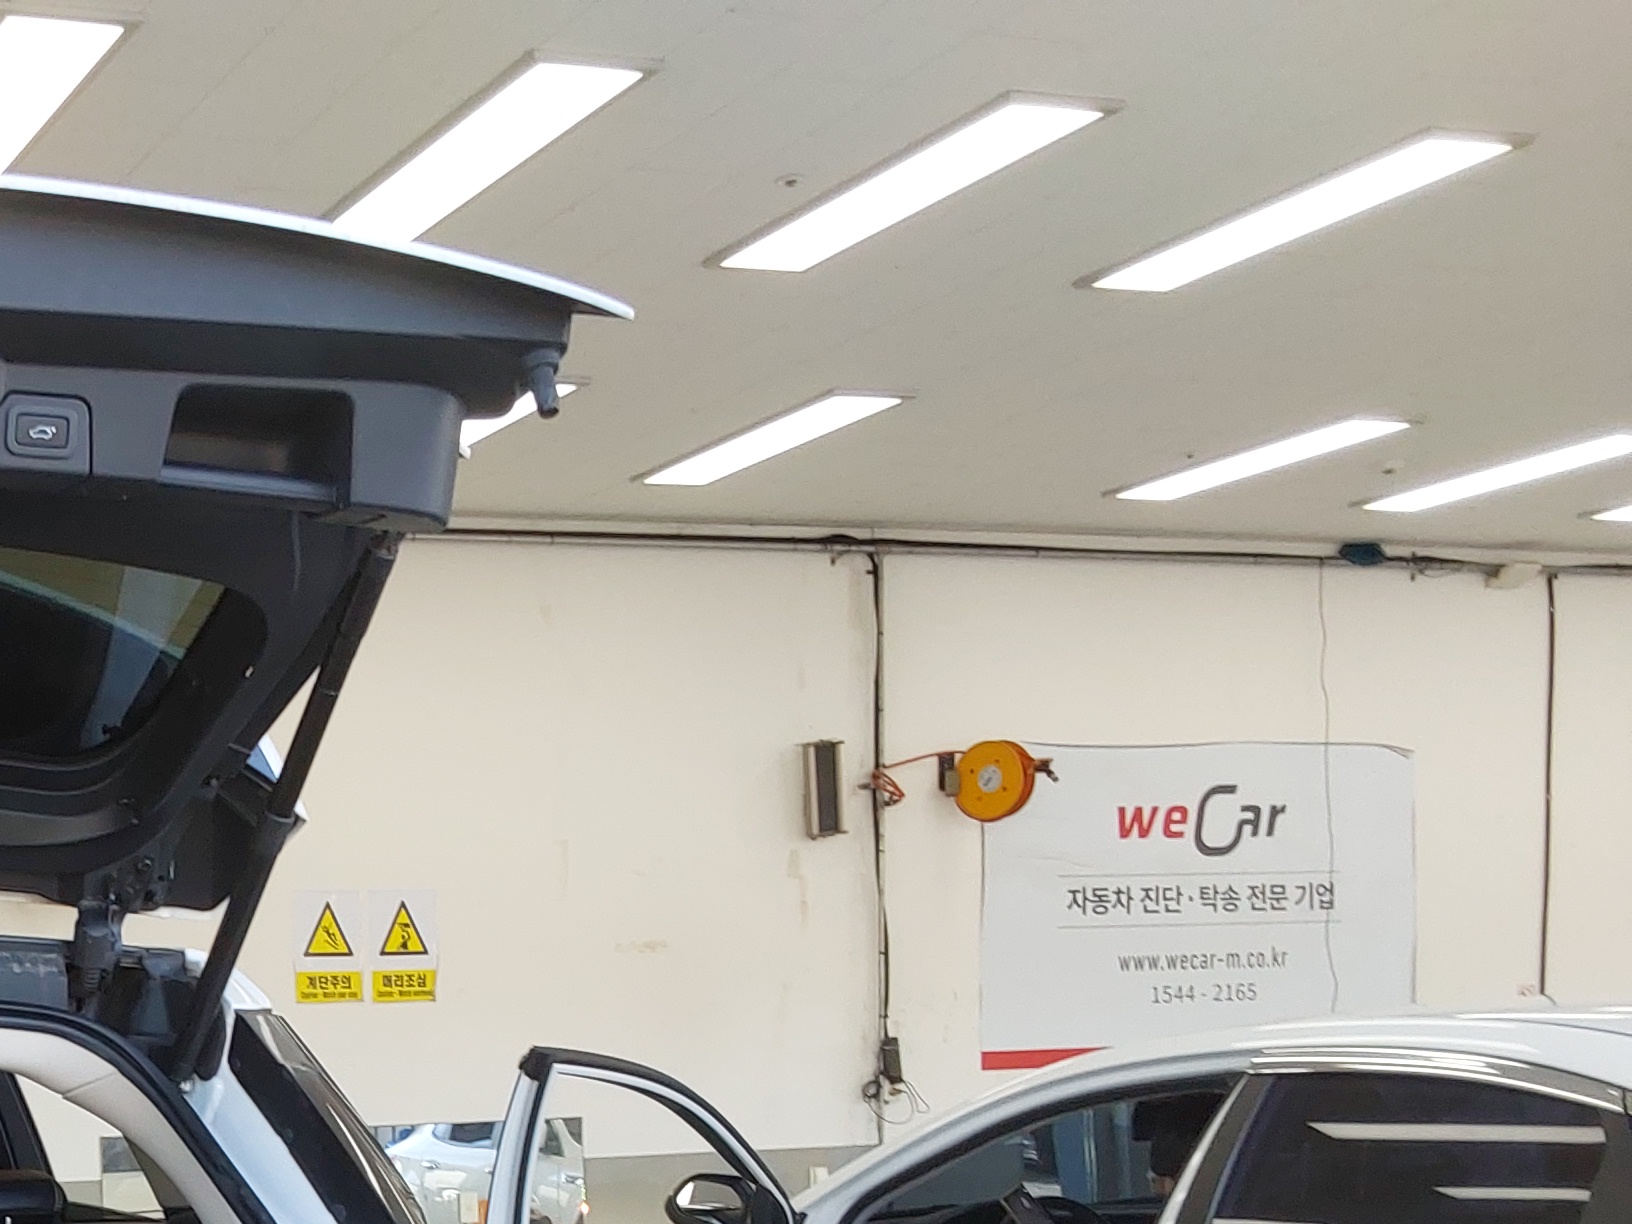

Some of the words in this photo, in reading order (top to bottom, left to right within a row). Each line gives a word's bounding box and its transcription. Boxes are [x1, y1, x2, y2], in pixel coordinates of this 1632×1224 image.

[1117, 784, 1287, 856] weCar
[1067, 886, 1134, 915] 자동차
[1247, 883, 1290, 912] 전문
[1294, 881, 1335, 911] 기업
[1118, 945, 1289, 972] www.wecar-m.co.kr
